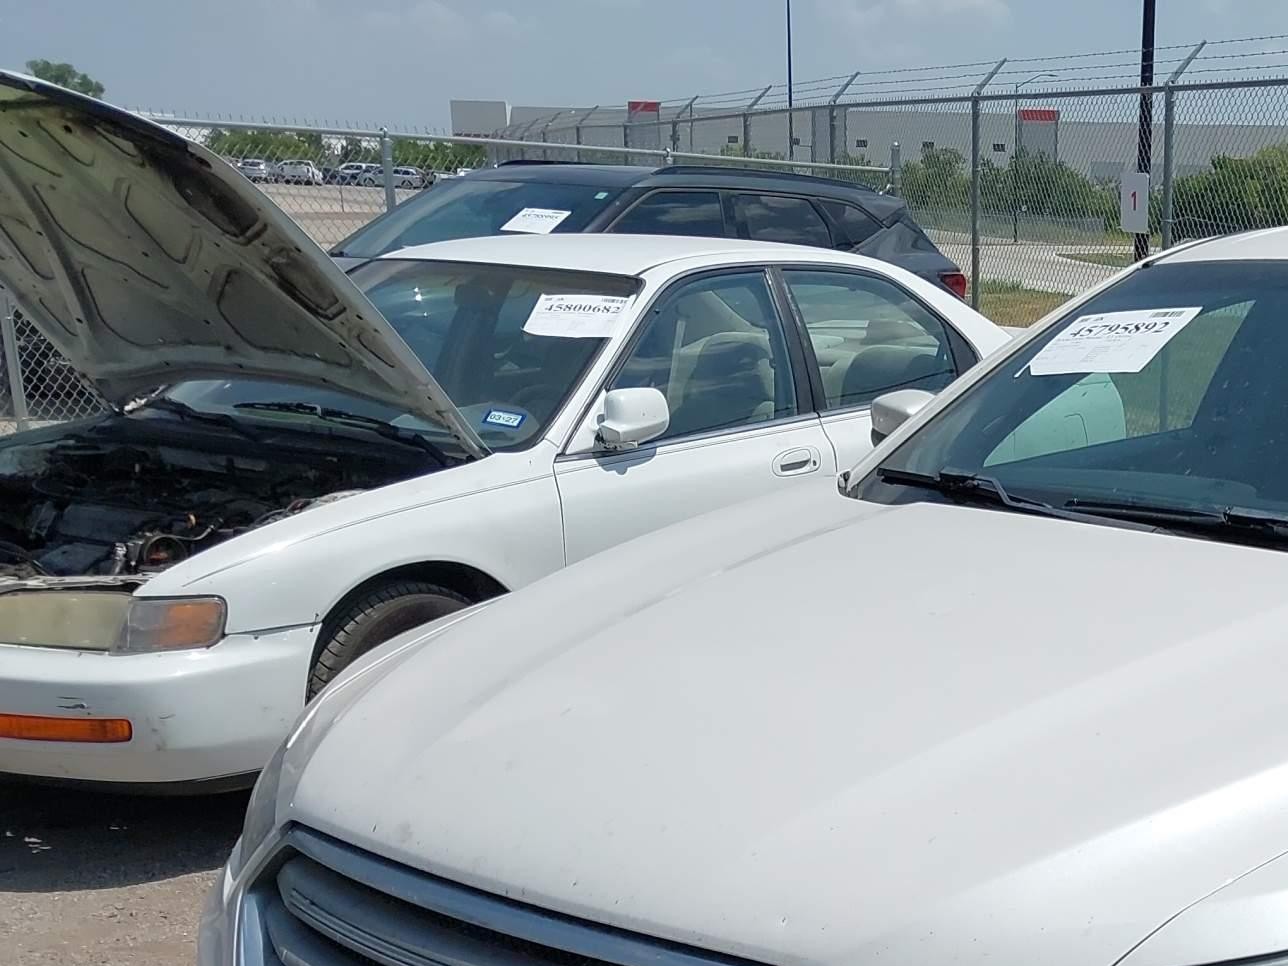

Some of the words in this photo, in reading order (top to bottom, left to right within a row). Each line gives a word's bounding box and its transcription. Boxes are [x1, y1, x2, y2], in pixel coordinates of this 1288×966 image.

[1131, 191, 1137, 211] 1
[544, 303, 621, 314] 45800682
[1069, 320, 1171, 339] 45795892
